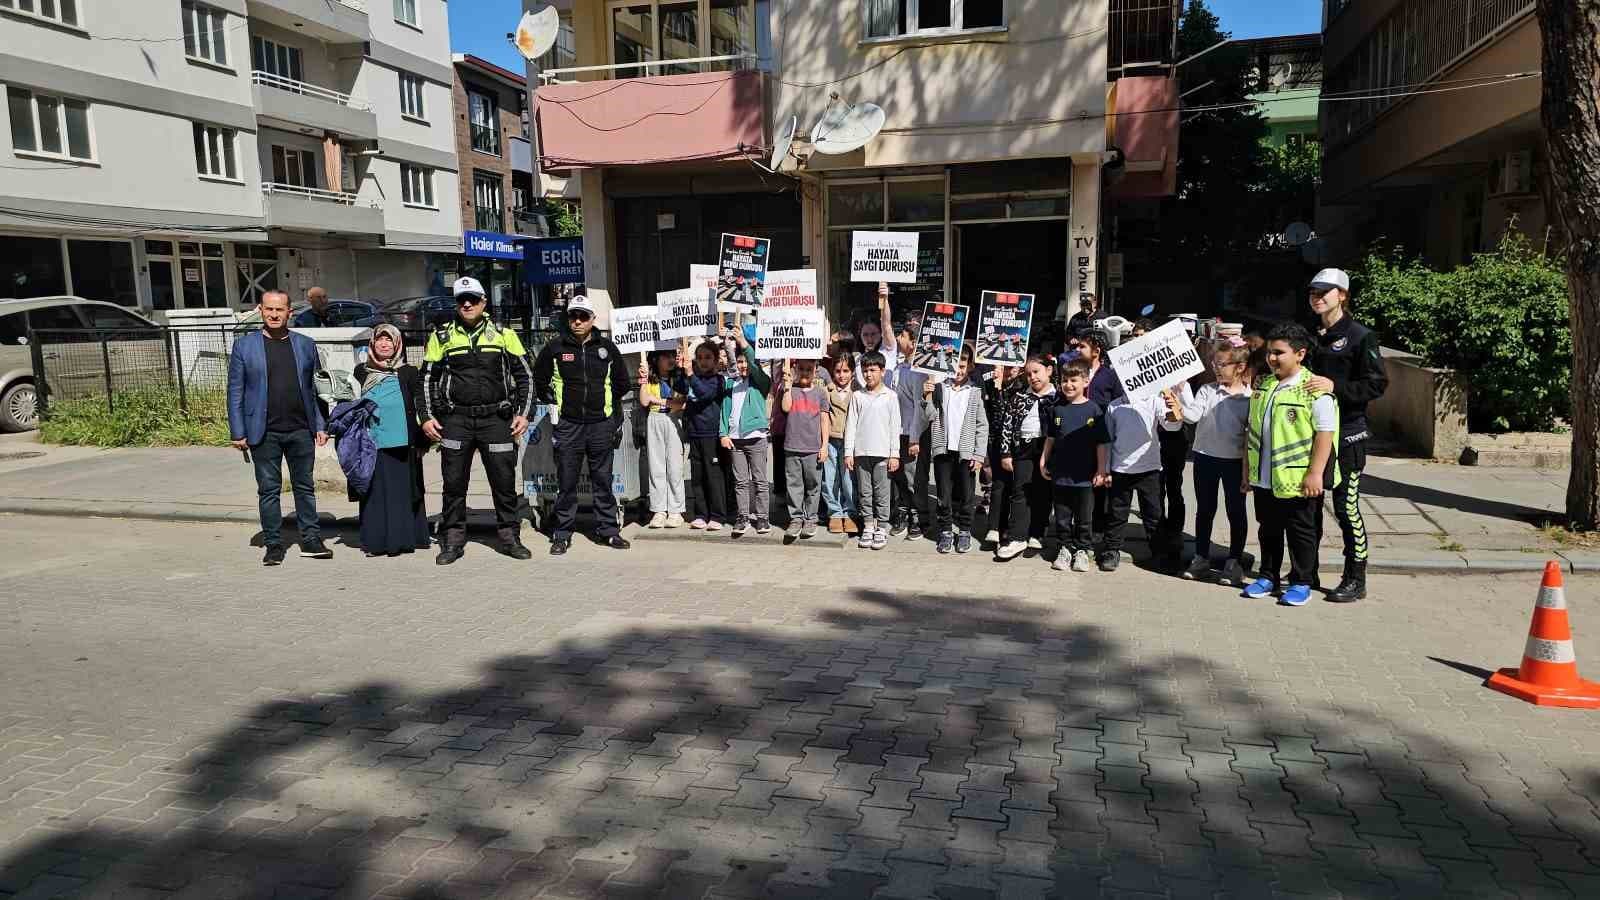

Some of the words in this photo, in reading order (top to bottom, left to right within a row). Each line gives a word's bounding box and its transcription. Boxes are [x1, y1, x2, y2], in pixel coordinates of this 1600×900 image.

[470, 236, 495, 251] Haier
[1073, 237, 1094, 248] TV
[867, 248, 899, 260] HAYATA
[548, 266, 582, 275] MARKET
[854, 260, 877, 271] SAYGI
[879, 261, 915, 272] DURUŞU
[772, 285, 800, 296] HAYATA
[762, 297, 780, 307] AYGI
[781, 296, 815, 306] DURUŞU
[672, 304, 700, 317] HAYATA
[628, 321, 658, 333] HAYATA
[661, 318, 681, 330] SAYGI
[682, 314, 716, 327] DURUŞU
[614, 333, 638, 345] SAYGI
[640, 330, 660, 342] DUR
[772, 326, 804, 337] HAYATA
[758, 338, 782, 348] SAYGI
[784, 338, 821, 350] DURUŞU
[1136, 346, 1175, 371] HAYATA
[1125, 368, 1158, 392] SAYGI
[1156, 349, 1197, 378] DURUŞU
